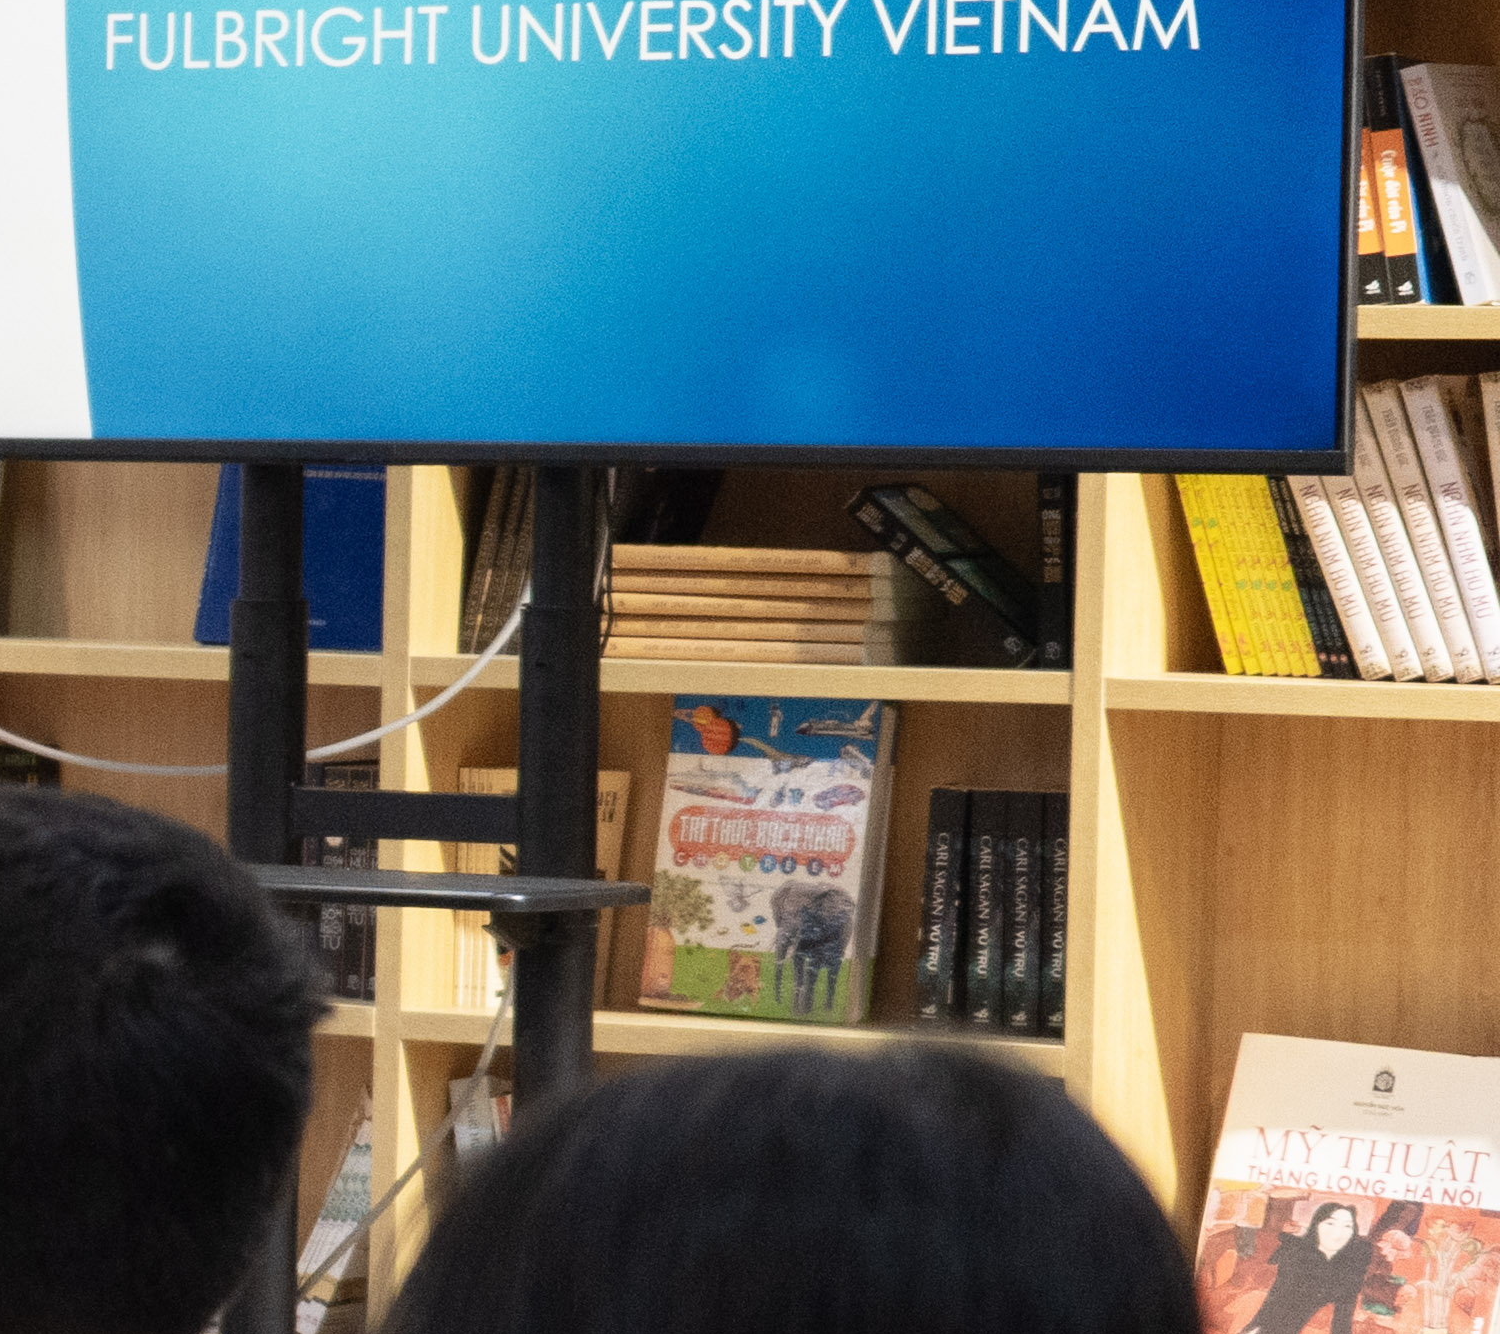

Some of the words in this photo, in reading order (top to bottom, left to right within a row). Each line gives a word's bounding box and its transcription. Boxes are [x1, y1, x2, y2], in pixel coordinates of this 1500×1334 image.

[105, 4, 450, 72] FULBRIGHT
[935, 831, 950, 866] CARL
[980, 835, 993, 870] CARL
[1015, 837, 1028, 873] CARL
[1053, 837, 1066, 873] CARL
[932, 869, 948, 917] SAGAN
[979, 873, 993, 920] SAGAN
[1014, 875, 1028, 923] SAGAN
[1053, 875, 1066, 923] SAGAN
[1251, 1124, 1328, 1164] MỸ
[1337, 1134, 1491, 1186] THUẬT
[1326, 1174, 1386, 1197] LONG
[1403, 1180, 1434, 1203] HÀ
[1441, 1184, 1483, 1207] NỘI
